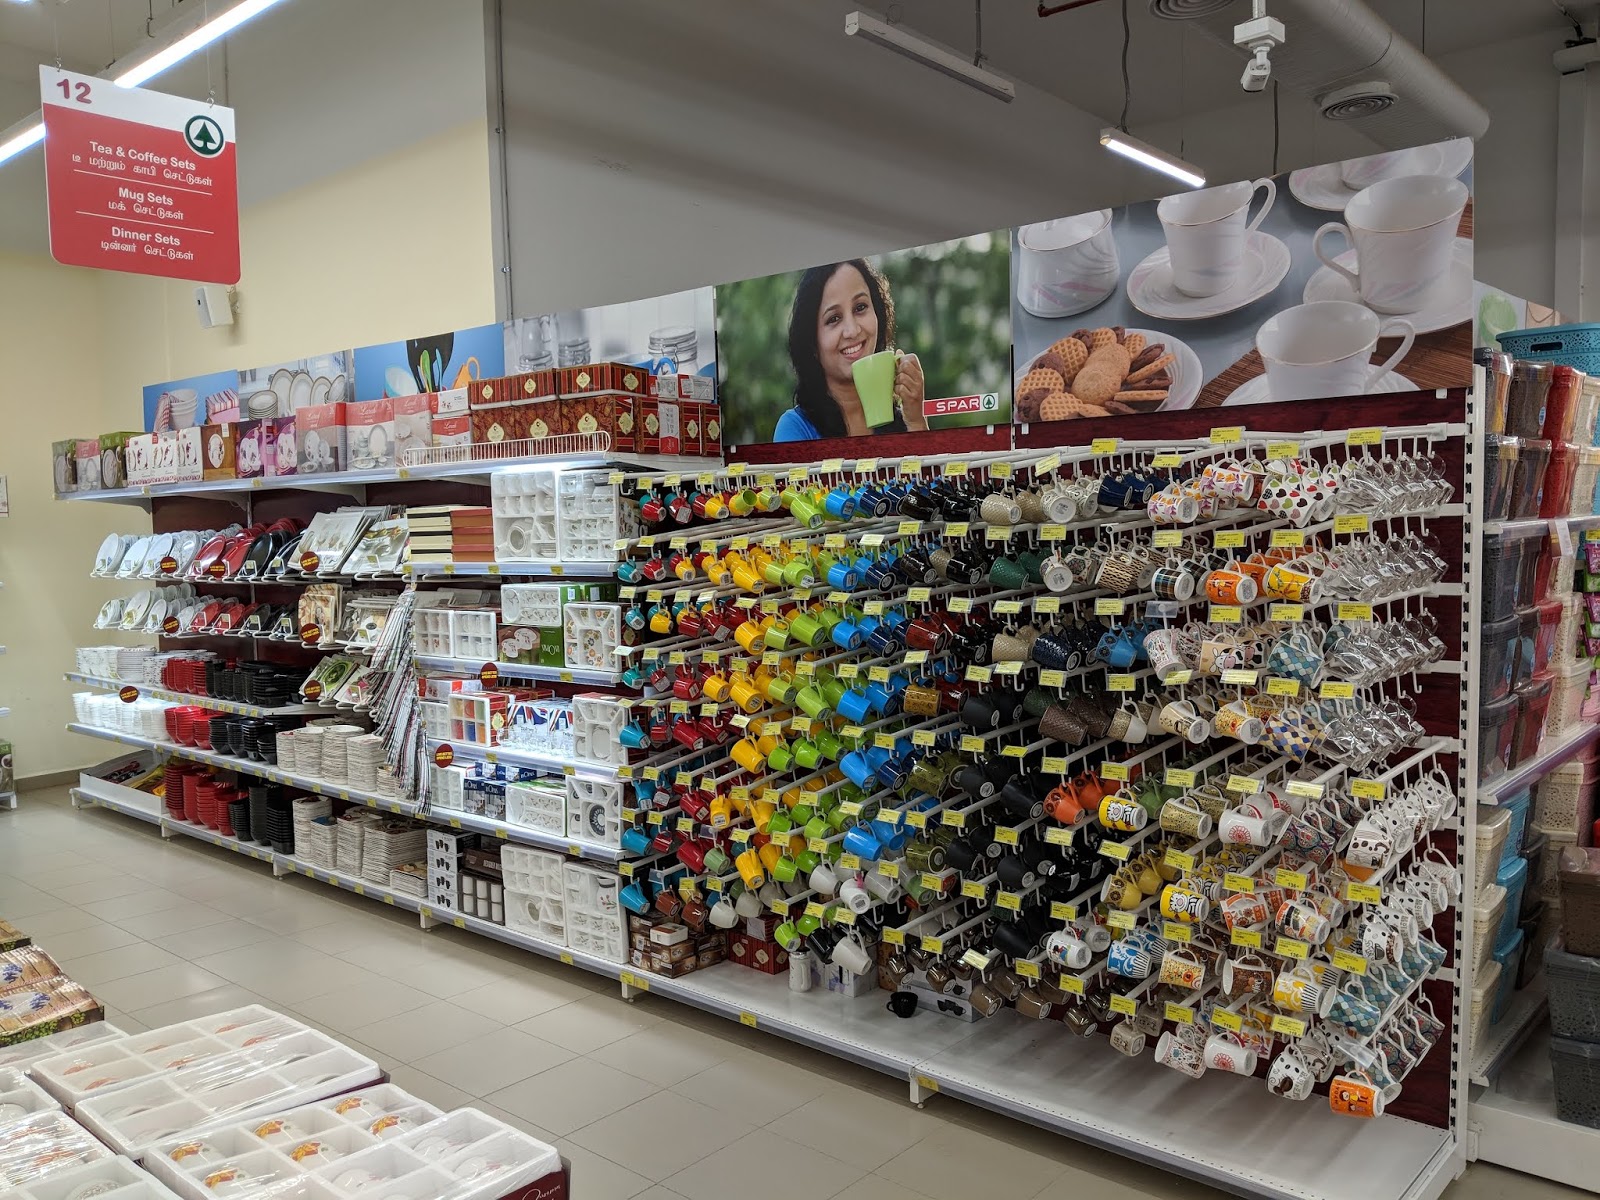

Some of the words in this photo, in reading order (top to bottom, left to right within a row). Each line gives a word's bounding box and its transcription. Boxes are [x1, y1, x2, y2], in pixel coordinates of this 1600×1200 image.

[56, 78, 92, 104] 12
[89, 141, 112, 155] Tea
[116, 146, 125, 158] &
[128, 149, 167, 165] Coffee
[170, 156, 196, 171] Sets
[89, 156, 126, 171] மற்றும்
[133, 163, 156, 176] காபி
[163, 168, 213, 187] செட்டுகள்
[118, 187, 144, 202] Mug
[147, 192, 173, 206] Sets
[133, 203, 184, 220] செட்டுகள்
[111, 226, 152, 242] Dinner
[154, 232, 181, 246] Sets
[144, 244, 194, 261] செட்டுகள்
[936, 398, 979, 412] SPAR
